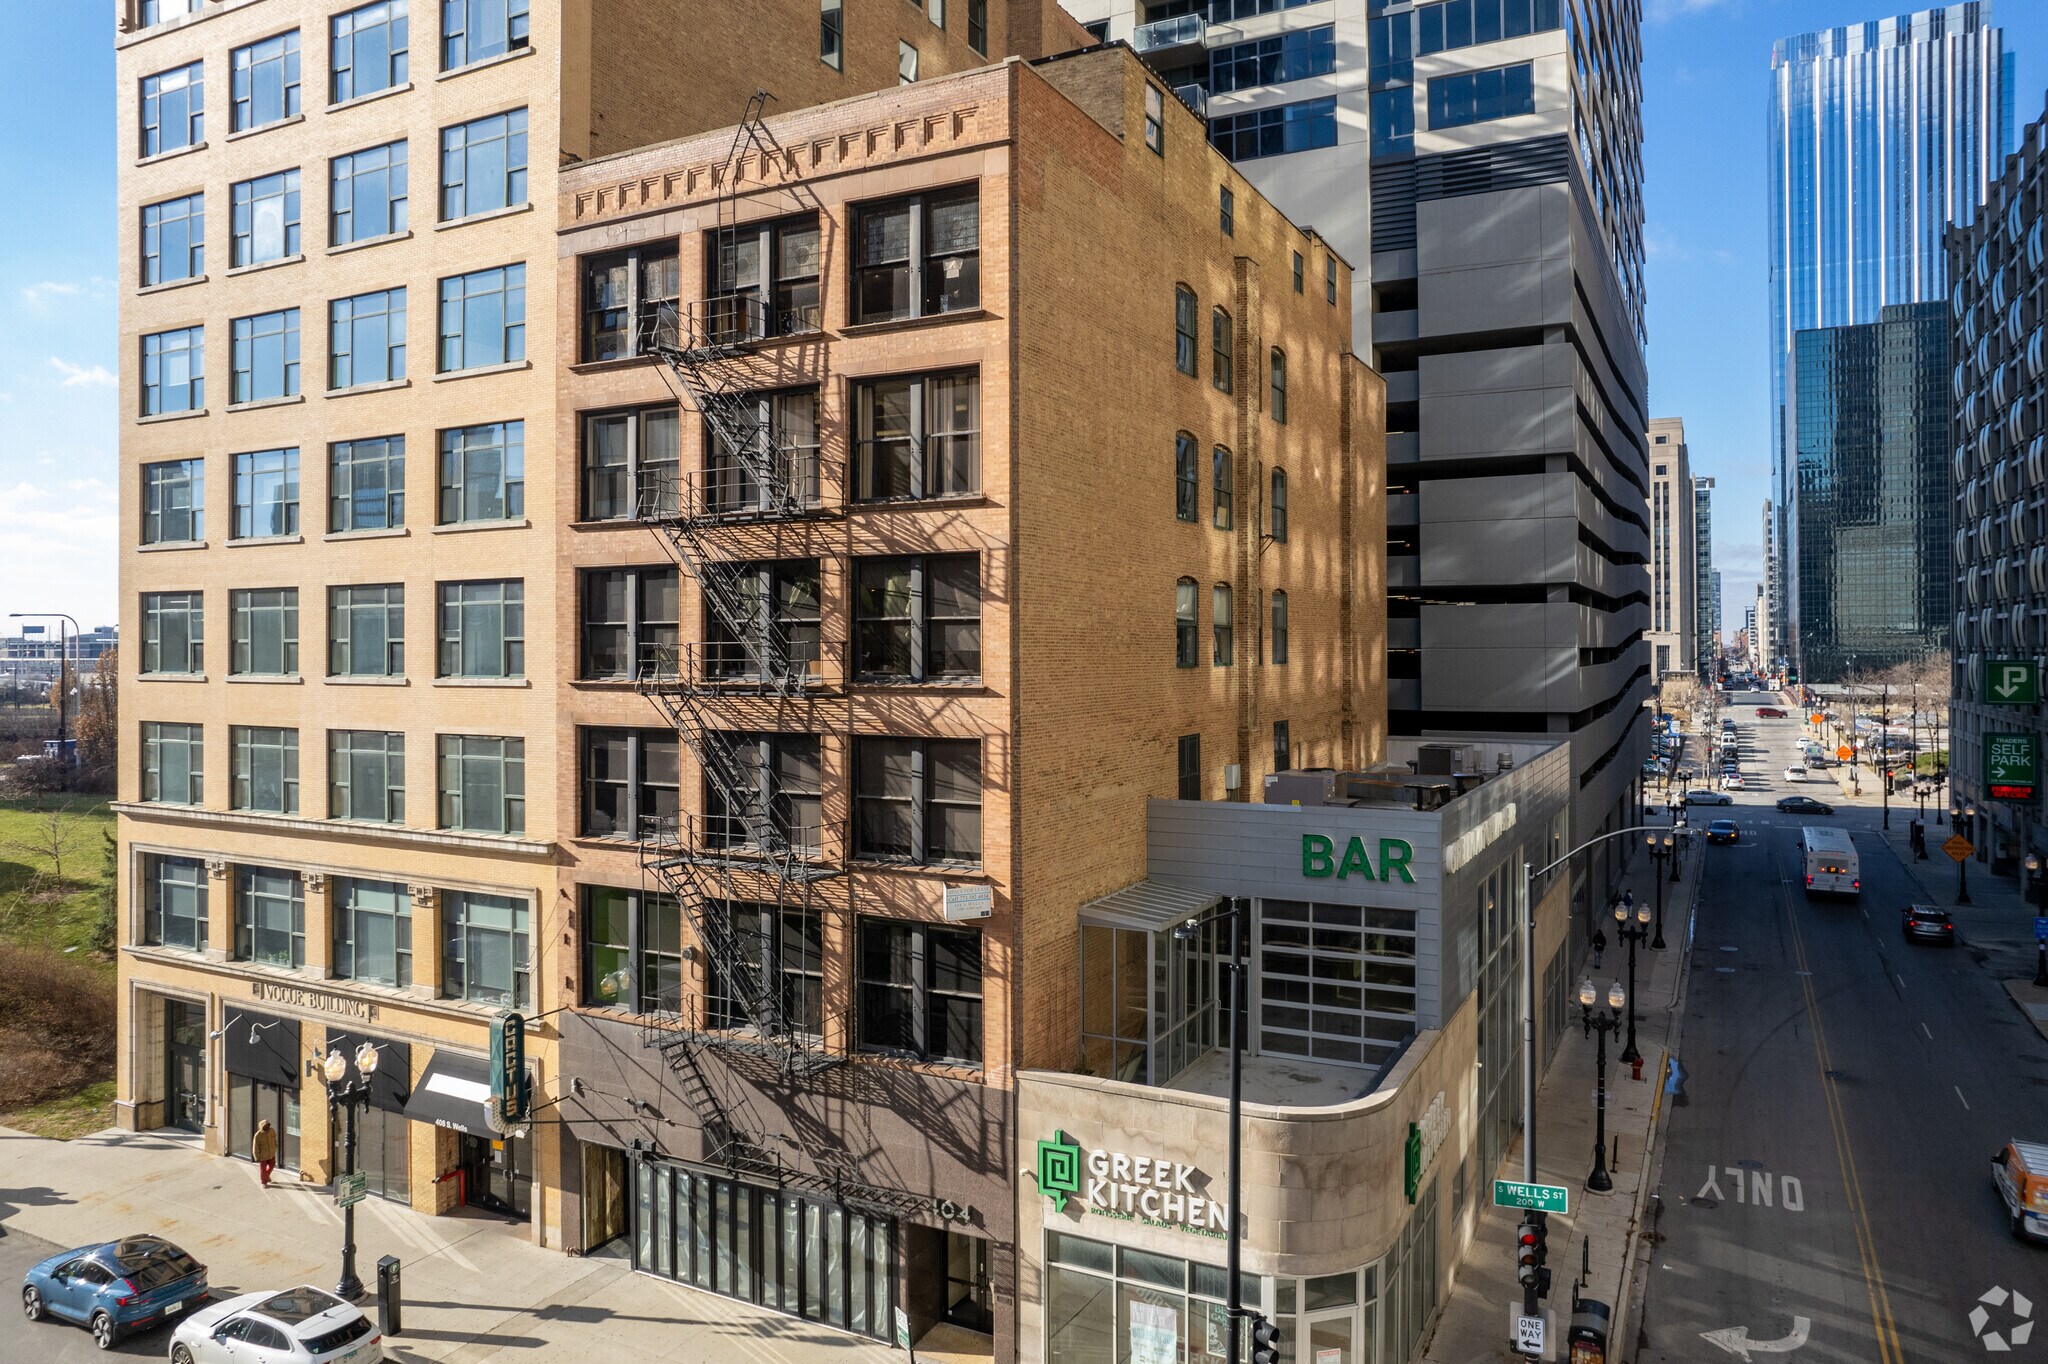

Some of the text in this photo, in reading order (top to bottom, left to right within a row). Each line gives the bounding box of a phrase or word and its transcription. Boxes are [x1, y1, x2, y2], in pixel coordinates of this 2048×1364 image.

[1995, 737, 2028, 745] TRADERS
[1991, 744, 2030, 755] SELF
[1991, 755, 2031, 767] PARK
[1302, 833, 1417, 884] BAR
[264, 983, 363, 1017] VOGUE BUILDING
[505, 1019, 518, 1117] CACTUS
[435, 1118, 446, 1127] 408
[452, 1122, 468, 1133] Wells
[1088, 1149, 1196, 1194] GREEK
[1498, 1185, 1563, 1199] S WELLS ST
[1696, 1165, 1805, 1212] ONLY
[1087, 1178, 1229, 1231] KITCHEN
[1516, 1197, 1545, 1208] 200 W
[1140, 1216, 1172, 1230] SALADS
[1520, 1319, 1541, 1330] ONE
[1520, 1329, 1542, 1340] WAY
